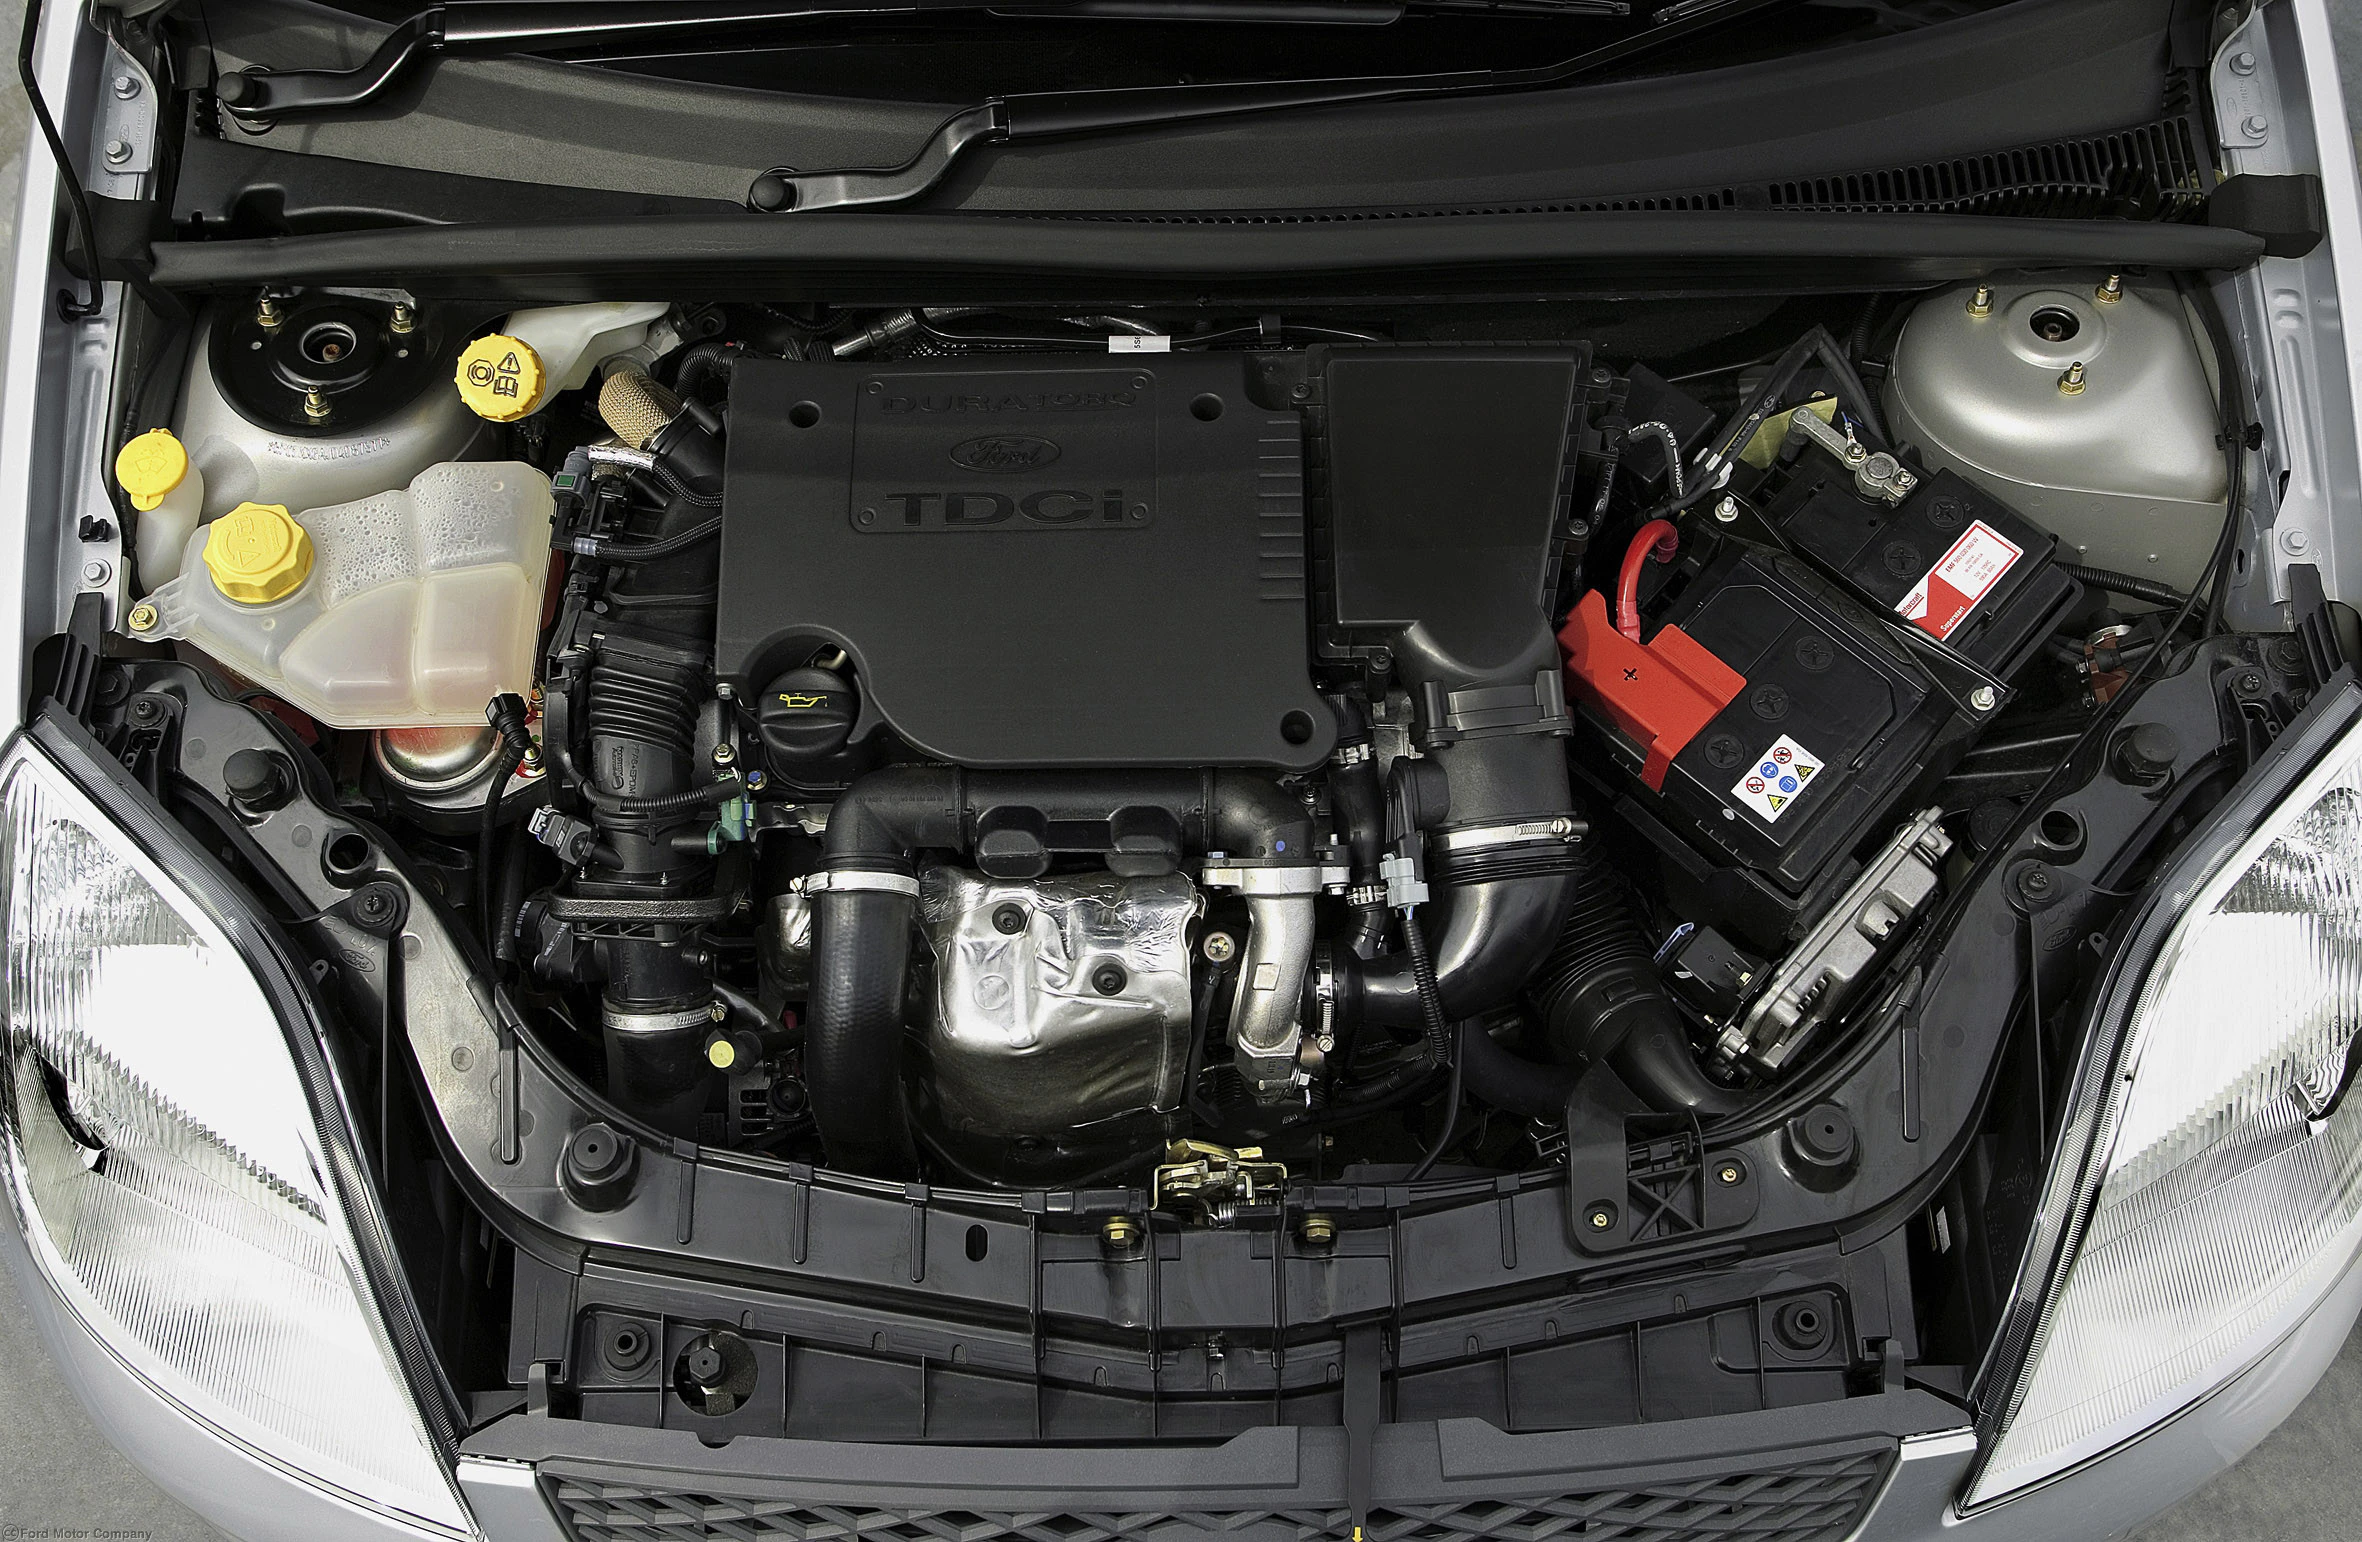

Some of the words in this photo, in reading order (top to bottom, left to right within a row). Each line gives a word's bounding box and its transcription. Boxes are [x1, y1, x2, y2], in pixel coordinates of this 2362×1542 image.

[881, 391, 1137, 415] DURATORQ
[964, 437, 1044, 467] Ford
[885, 489, 1123, 527] TDCi
[1939, 605, 1967, 632] Superstart
